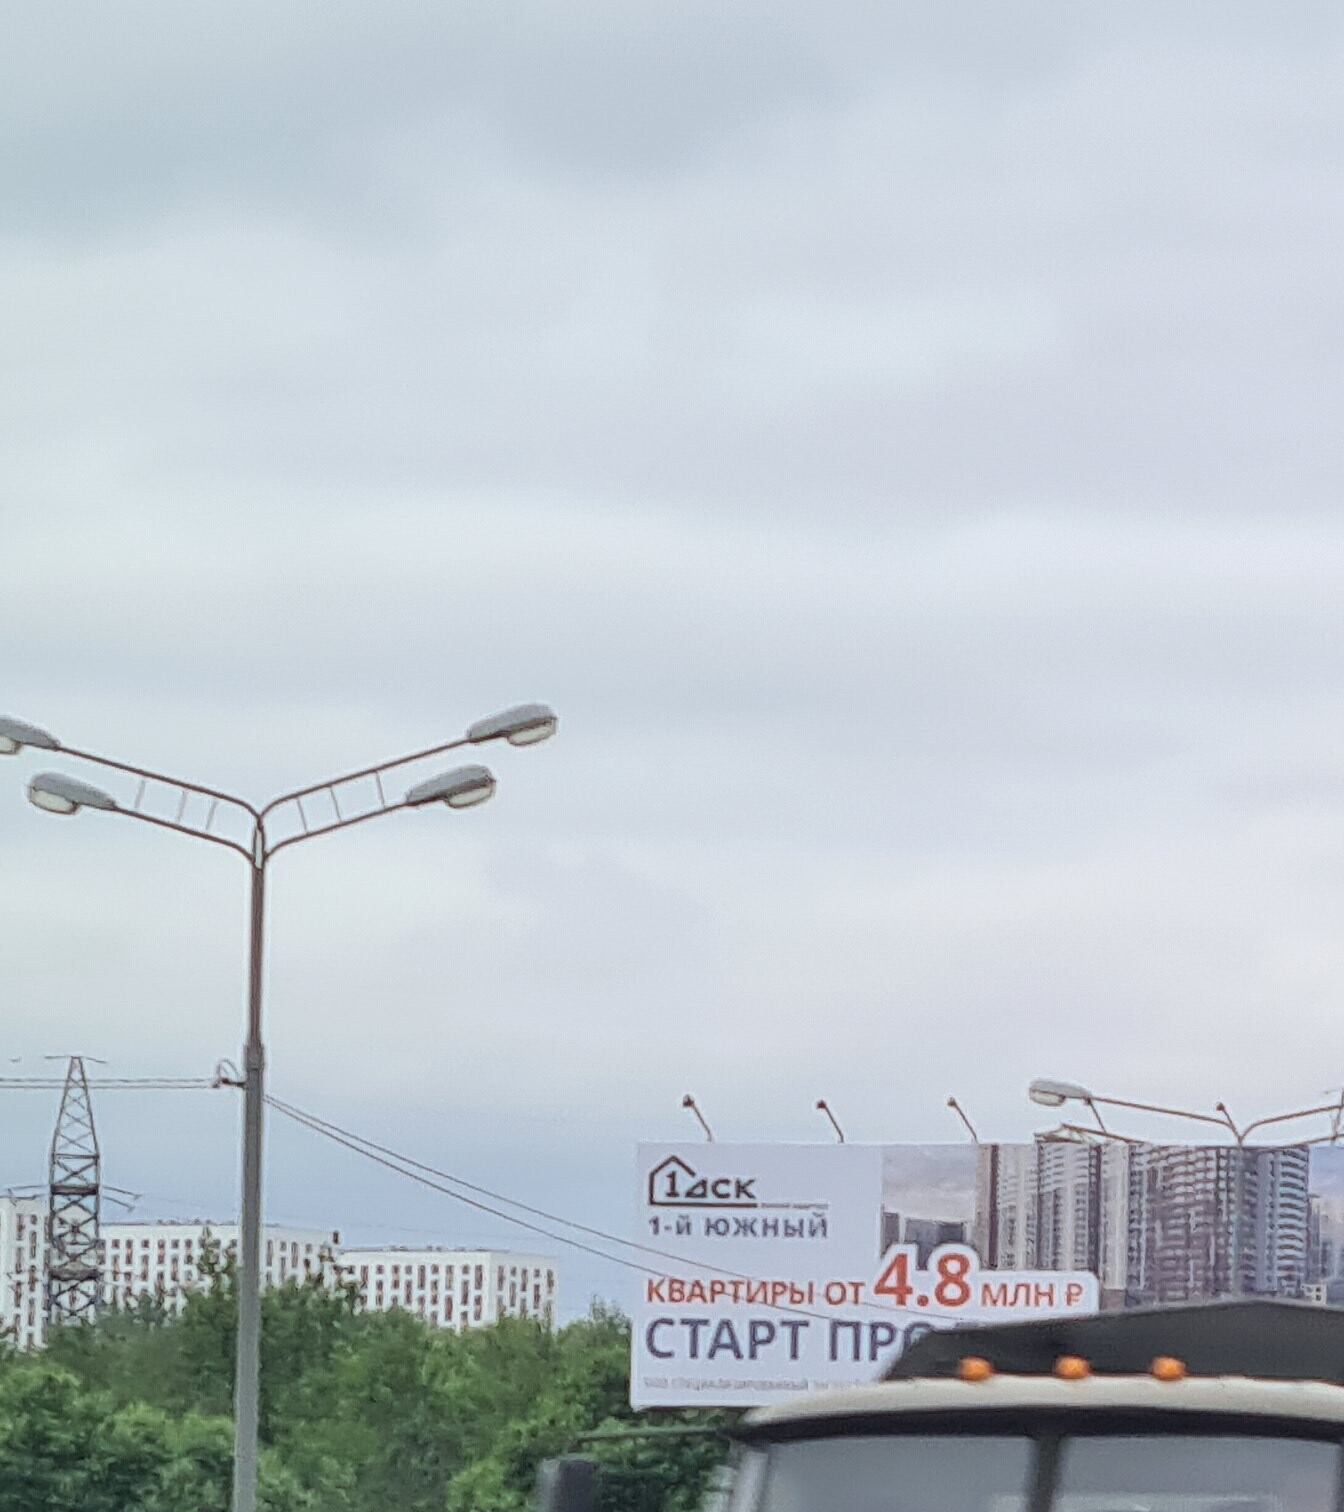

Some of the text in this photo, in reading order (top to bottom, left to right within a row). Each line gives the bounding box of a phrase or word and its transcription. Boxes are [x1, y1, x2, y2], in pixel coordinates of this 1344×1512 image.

[705, 1211, 829, 1239] ЮЖНЫЙ
[647, 1278, 814, 1305] КВАРТИРЫ
[824, 1280, 866, 1306] ОТ
[873, 1252, 972, 1308] 4.8
[980, 1283, 1055, 1307] МЛН
[645, 1317, 810, 1361] СТАРТ
